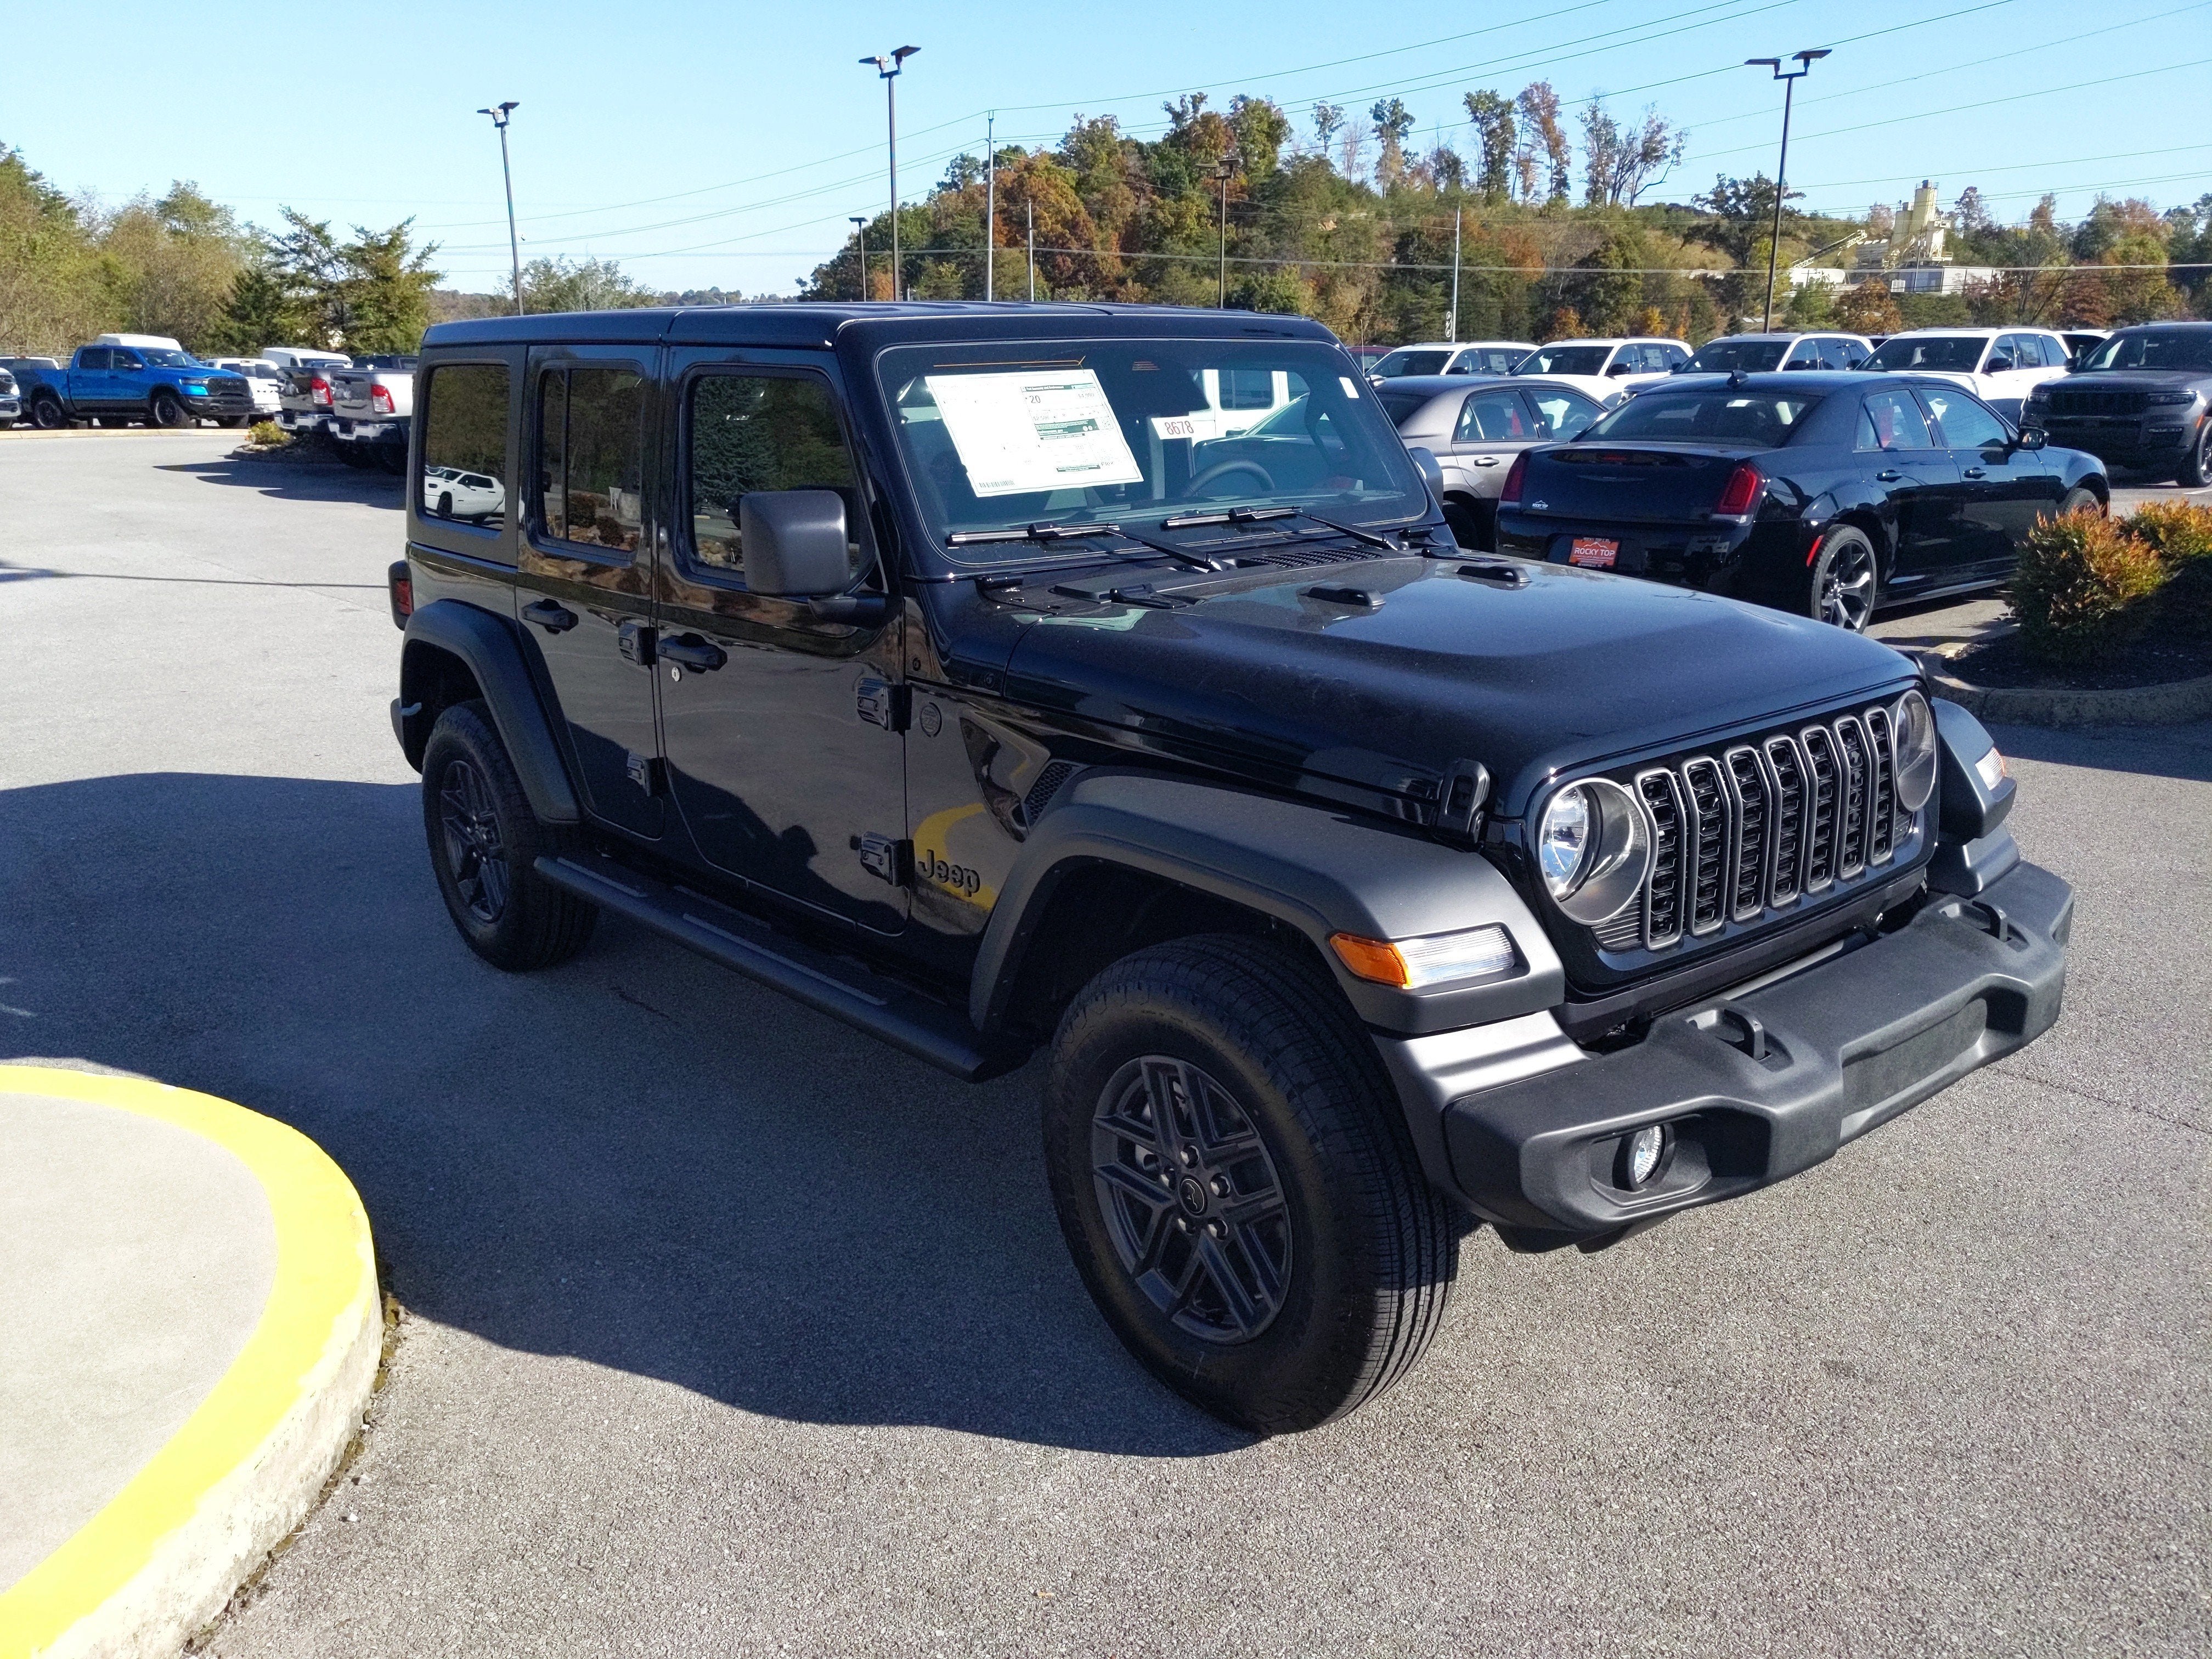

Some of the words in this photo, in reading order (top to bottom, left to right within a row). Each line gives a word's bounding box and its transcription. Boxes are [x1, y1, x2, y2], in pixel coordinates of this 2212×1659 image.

[1030, 395, 1041, 403] 20
[1164, 420, 1194, 435] 8678
[1574, 548, 1599, 556] ROCKY
[918, 849, 980, 898] Jeep
